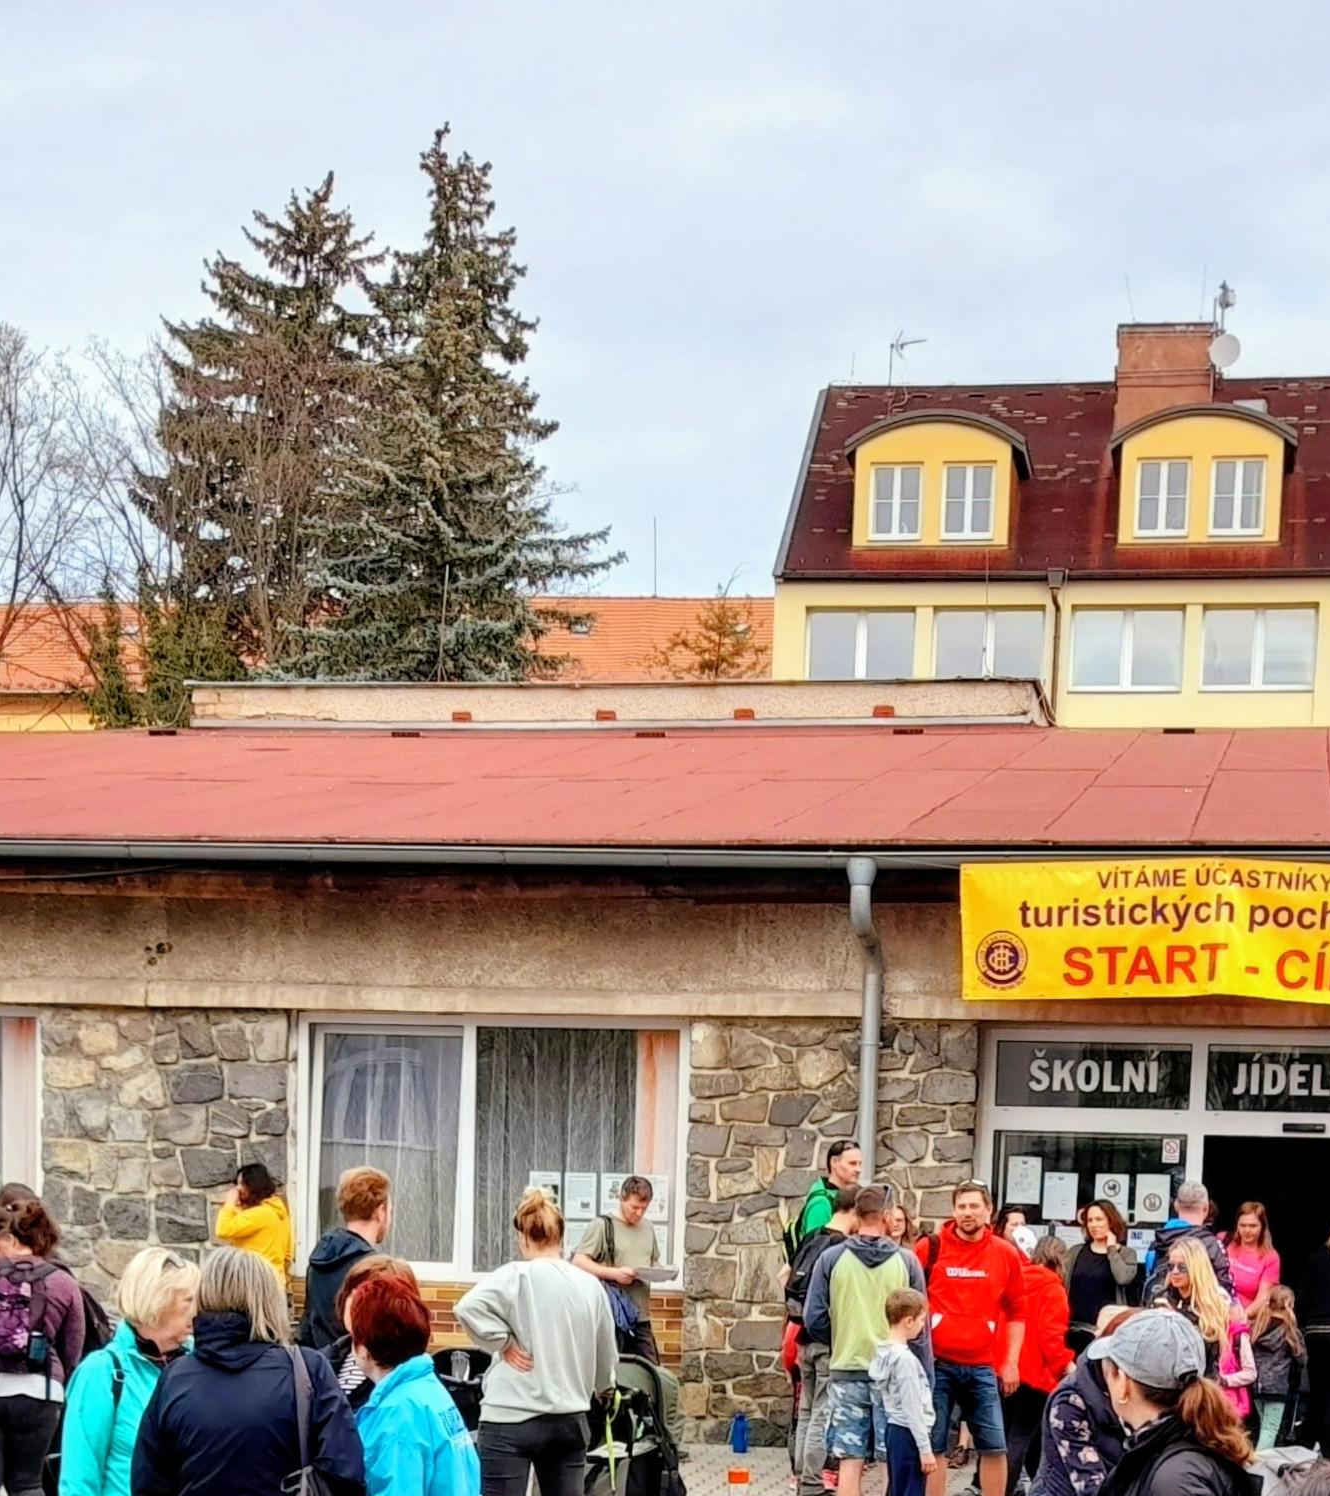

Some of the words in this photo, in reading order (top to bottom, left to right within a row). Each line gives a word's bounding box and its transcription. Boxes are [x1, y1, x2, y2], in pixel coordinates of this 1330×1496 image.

[1097, 865, 1187, 889] VÍTÁME
[1019, 893, 1235, 933] turistických
[1062, 943, 1228, 987] START
[1245, 966, 1260, 975] -
[1028, 1049, 1160, 1094] ŠKOLNÍ
